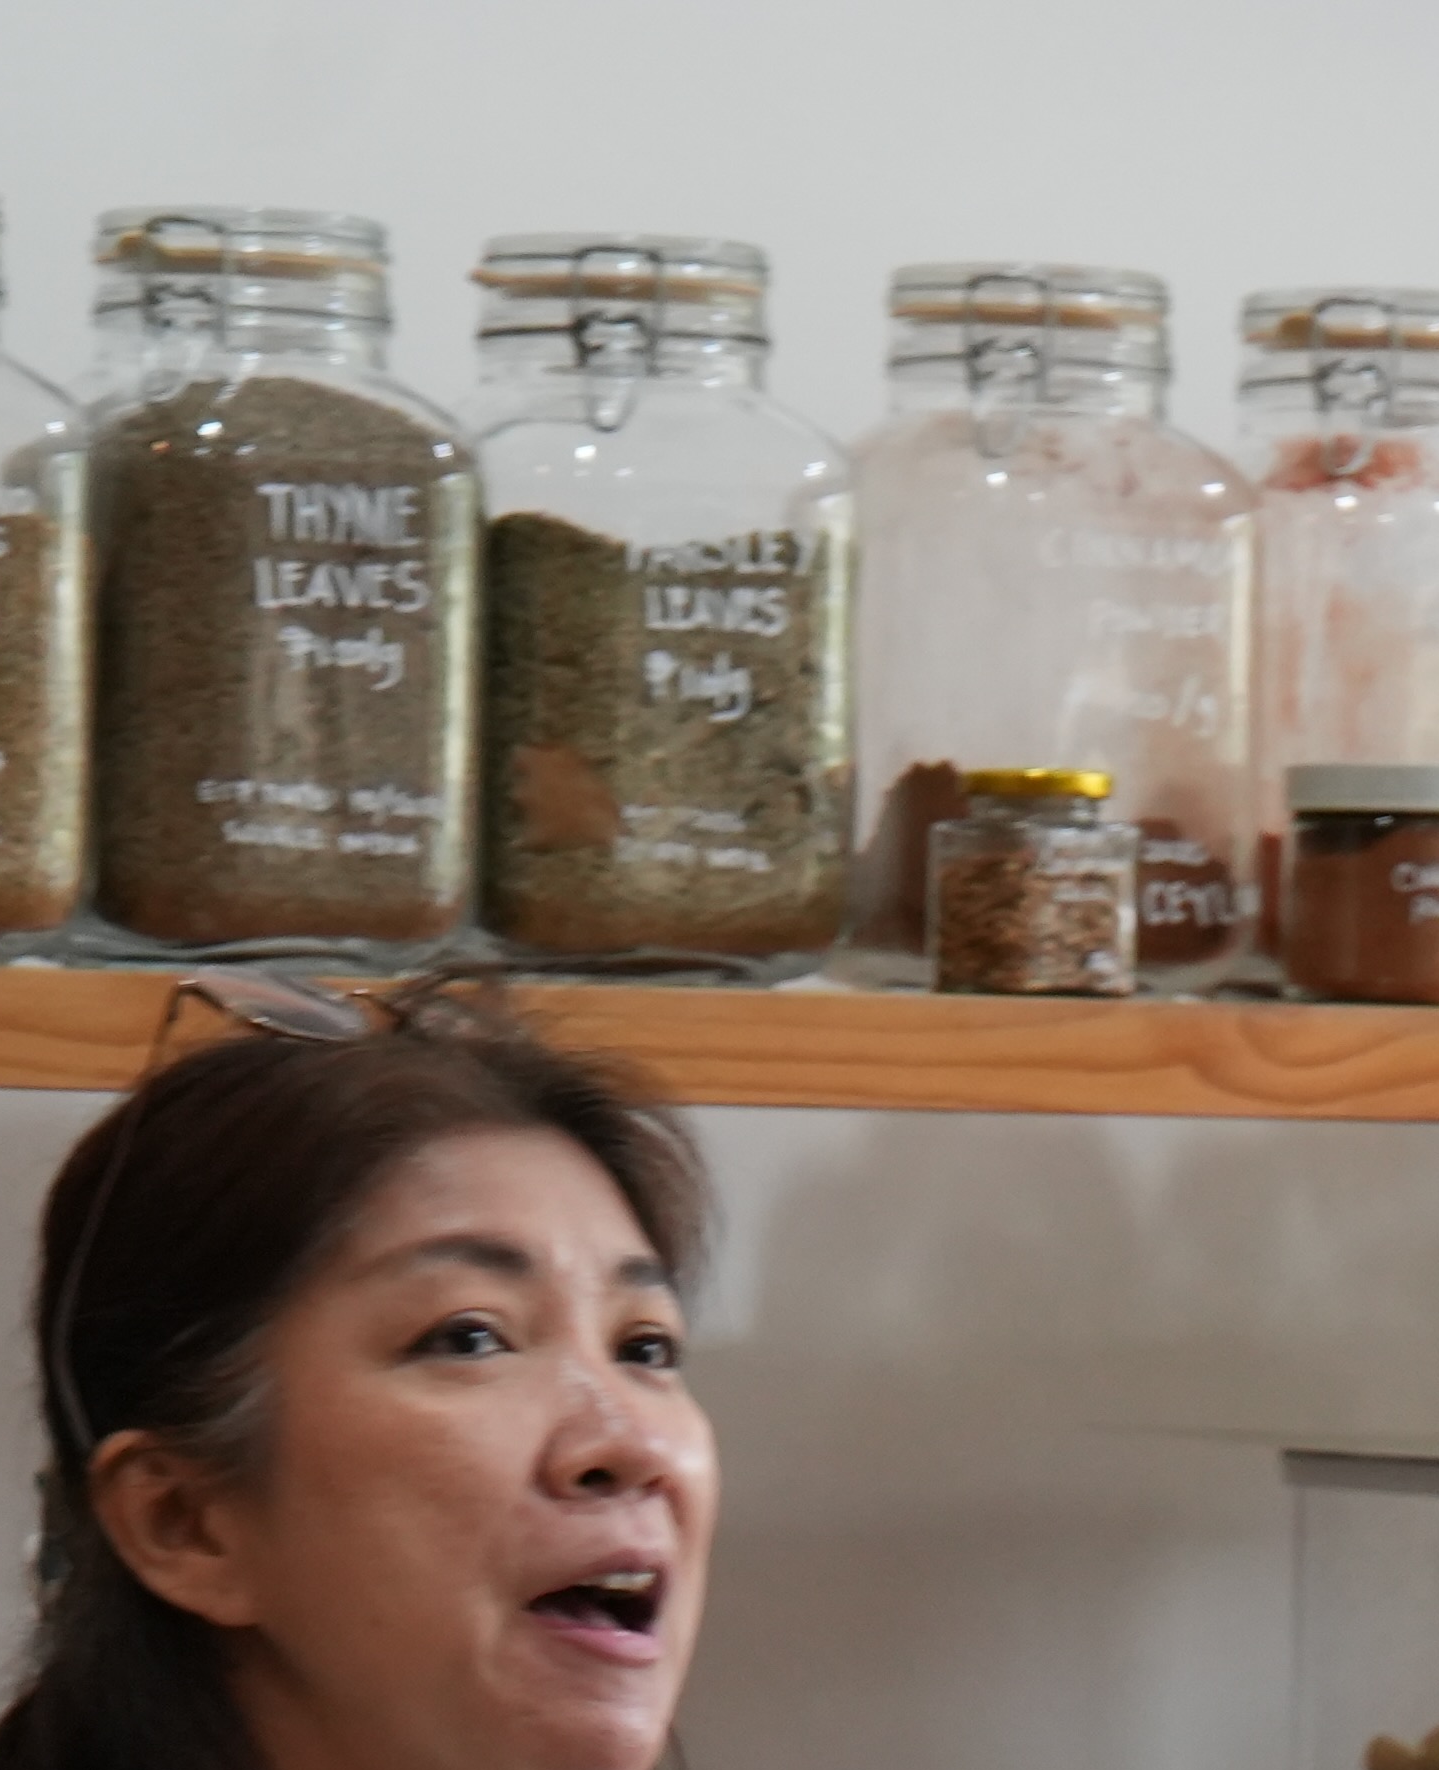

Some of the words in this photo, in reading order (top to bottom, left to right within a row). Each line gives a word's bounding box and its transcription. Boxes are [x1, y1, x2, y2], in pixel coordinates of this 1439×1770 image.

[256, 482, 420, 548] THYME
[252, 556, 432, 613] LEAVES
[643, 586, 791, 638] LEAVES
